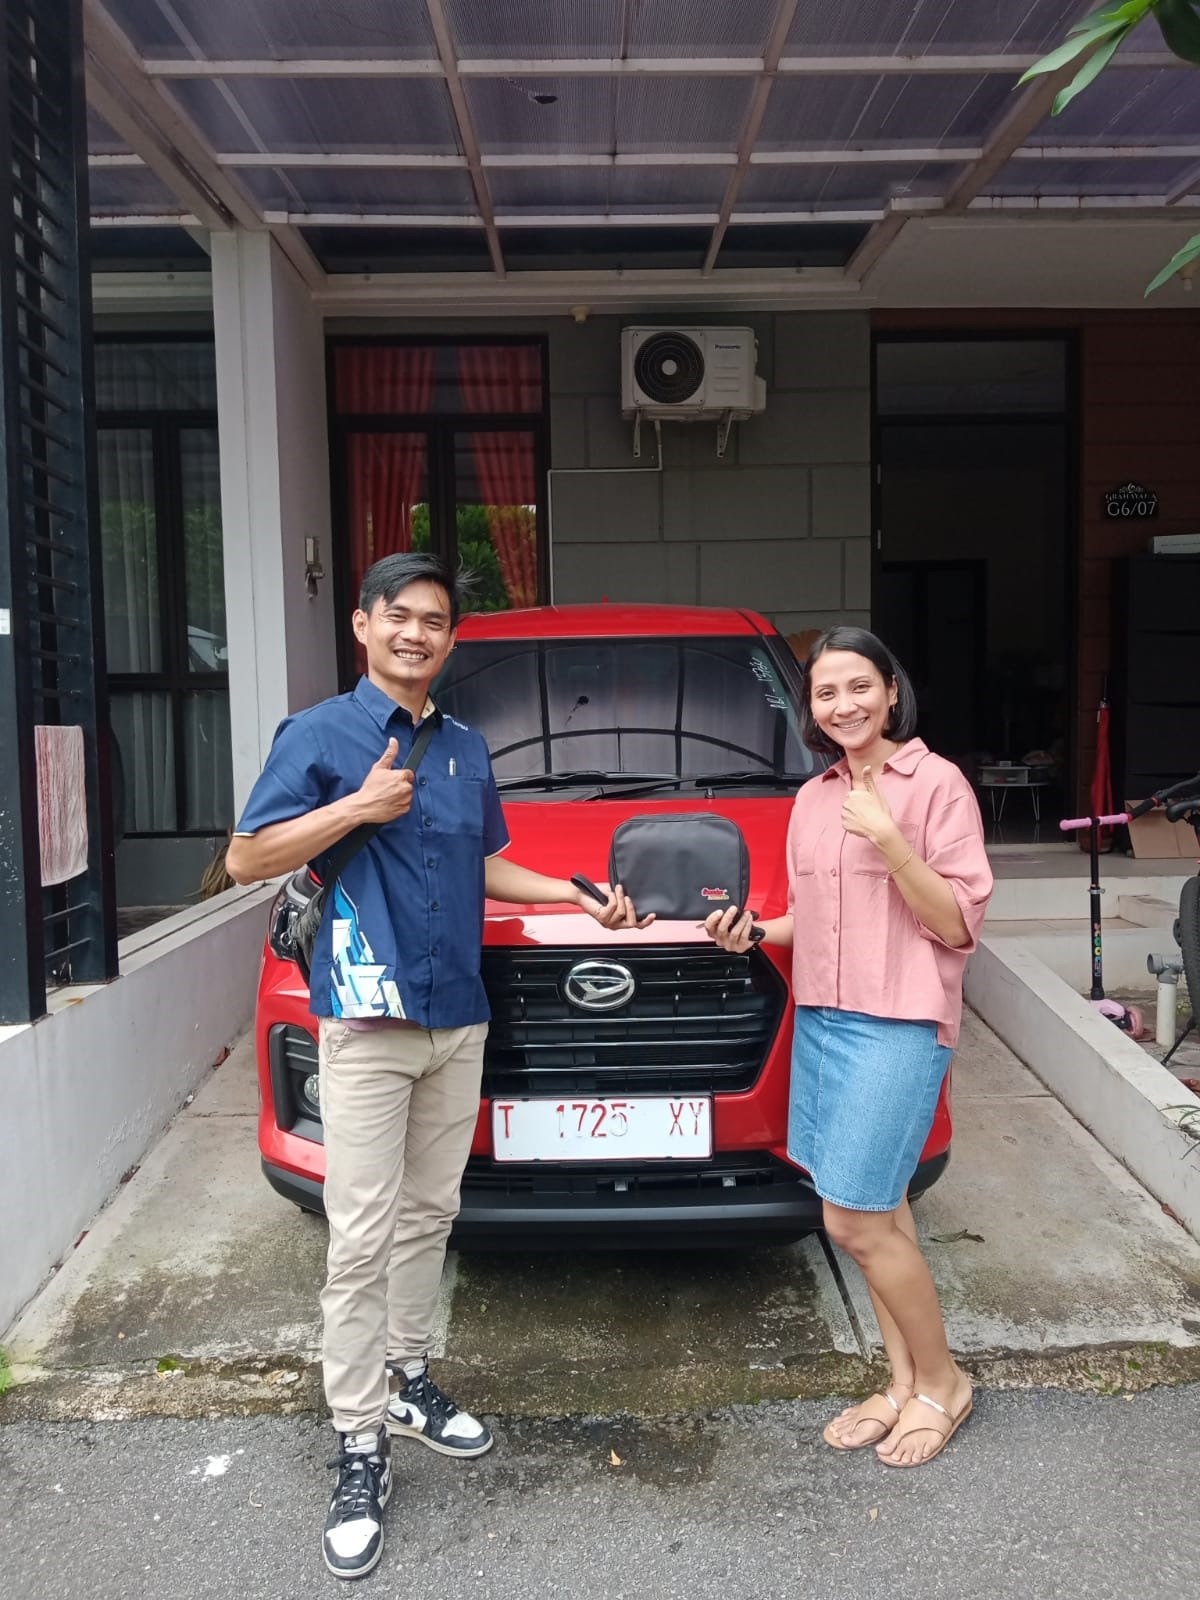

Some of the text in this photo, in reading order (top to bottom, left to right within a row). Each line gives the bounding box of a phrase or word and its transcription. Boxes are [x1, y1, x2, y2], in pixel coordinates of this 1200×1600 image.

[1107, 501, 1155, 516] G6/07
[498, 1102, 704, 1138] T 1725 XY
